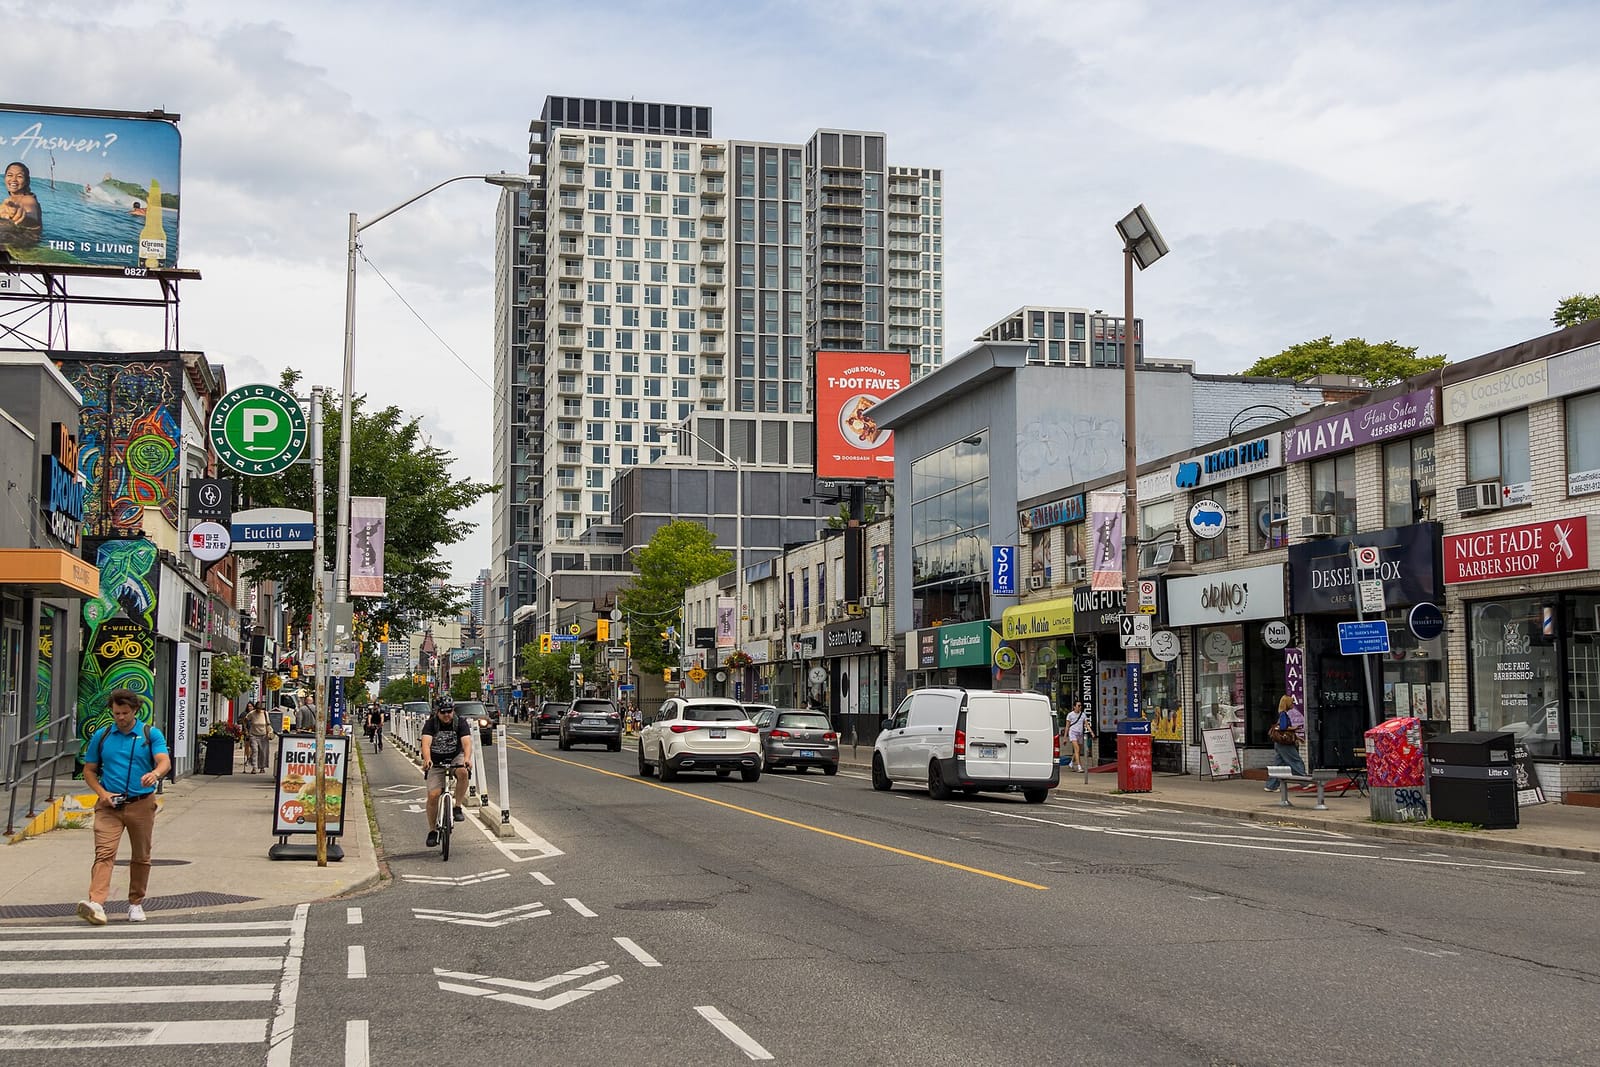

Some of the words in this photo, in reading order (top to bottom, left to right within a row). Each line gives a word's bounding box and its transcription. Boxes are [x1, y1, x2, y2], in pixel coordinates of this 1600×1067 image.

[12, 122, 118, 160] Answer?
[49, 240, 75, 251] THIS
[80, 241, 91, 252] IS
[96, 242, 133, 254] LIVING
[141, 240, 164, 248] Corona
[124, 268, 147, 277] 0827
[844, 367, 860, 376] YOUR
[860, 366, 877, 374] DOOR
[878, 369, 886, 377] TO
[828, 378, 863, 389] T-DOT
[866, 378, 900, 390] FAVES
[1471, 366, 1546, 400] Coast2Coast
[215, 388, 301, 426] MUNICIPAL
[1360, 410, 1386, 430] Hair
[1388, 402, 1417, 420] Salon
[243, 408, 278, 442] P
[1370, 418, 1416, 438] 416-588-1480
[1296, 418, 1354, 456] MAYA
[216, 437, 301, 472] PARKING
[1219, 470, 1232, 479] PHOTO
[1066, 496, 1082, 520] SPA
[244, 526, 282, 539] Euclid
[288, 528, 301, 538] Av
[1456, 536, 1494, 560] NICE
[1500, 528, 1542, 554] FADE
[997, 548, 1008, 585] Spa
[1458, 559, 1501, 578] BARBER
[1506, 554, 1540, 573] SHOP
[1312, 567, 1365, 589] DESSE
[1073, 592, 1098, 612] KUNG
[1100, 590, 1113, 610] FU
[1117, 590, 1126, 606] TE
[1016, 616, 1027, 636] Ave
[1268, 626, 1286, 636] Nail
[828, 632, 847, 647] Seaton
[848, 628, 862, 647] Vape
[1269, 636, 1287, 645] Salon
[201, 658, 210, 679] 마포
[1494, 672, 1534, 680] BARBERSHOP
[1497, 662, 1512, 670] NICE
[1513, 662, 1530, 670] FADE
[1083, 675, 1091, 700] KUNG
[1286, 653, 1299, 705] MAYA
[200, 692, 209, 727] 감자탕
[286, 751, 306, 764] BIG
[308, 752, 342, 764] MRY
[288, 764, 337, 776] MONAY
